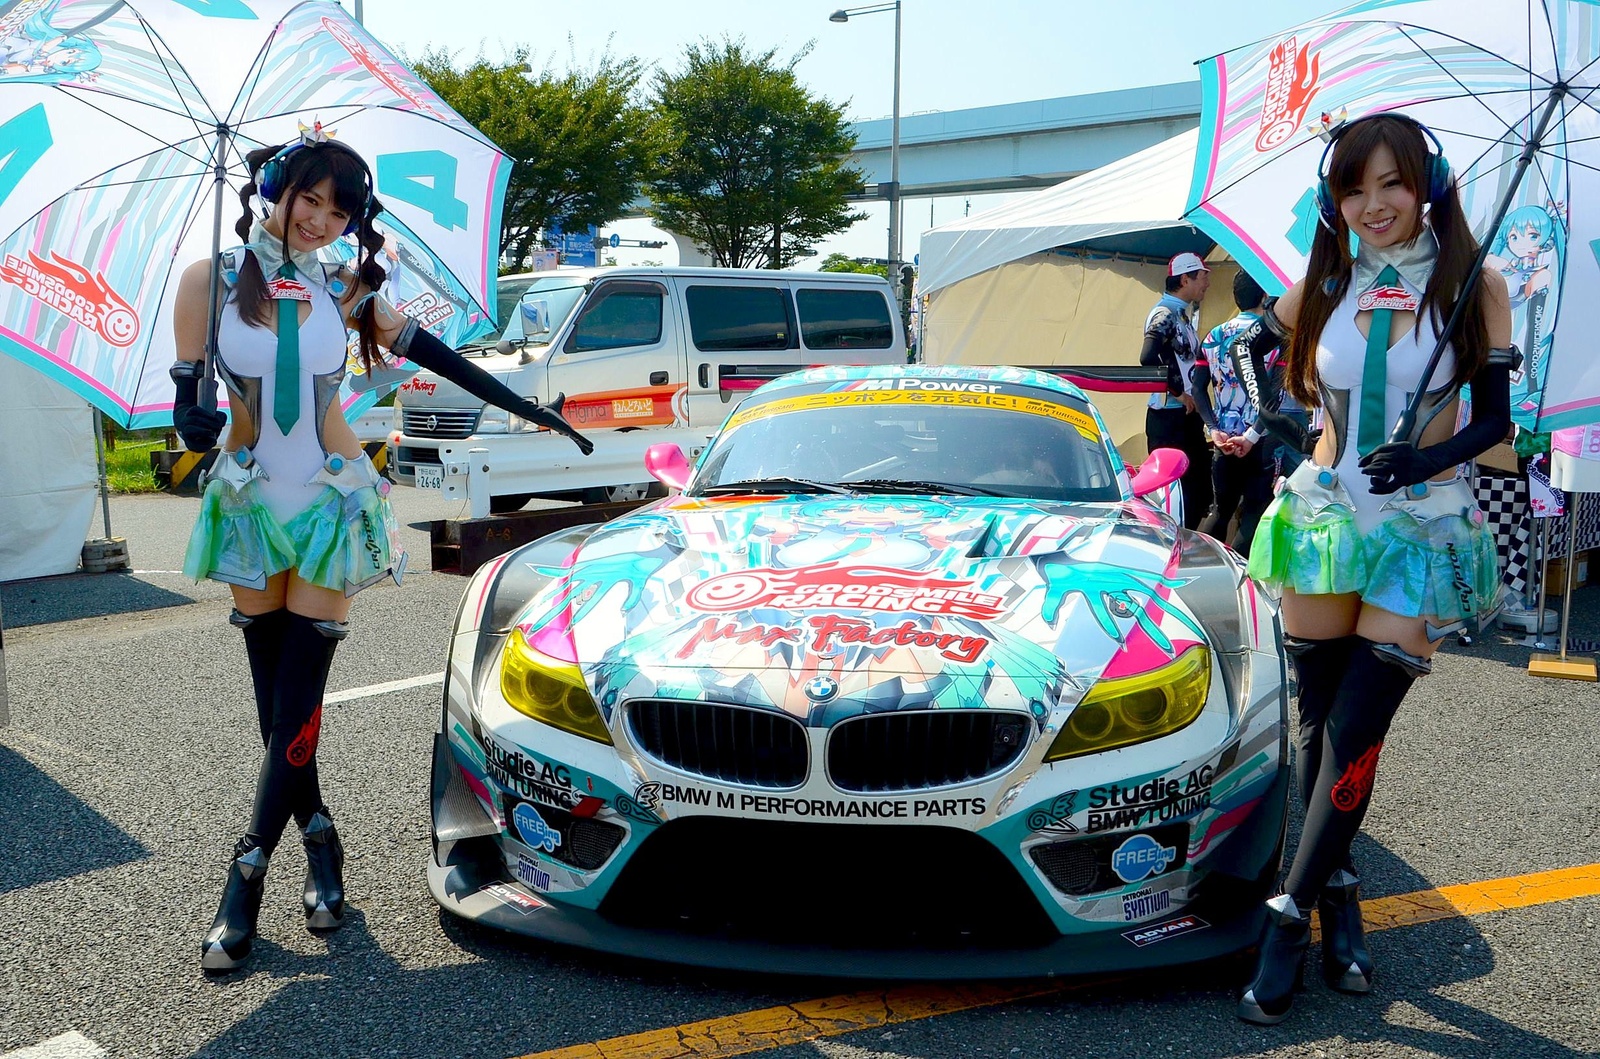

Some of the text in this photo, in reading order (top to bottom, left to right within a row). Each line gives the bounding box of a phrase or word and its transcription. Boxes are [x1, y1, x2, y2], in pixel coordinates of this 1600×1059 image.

[898, 378, 1002, 394] Power
[1051, 409, 1088, 426] TURISMO
[1446, 542, 1473, 612] CRYPTON
[768, 594, 943, 612] RACING
[793, 583, 1002, 607] GOODSMILE
[674, 614, 989, 663] Max Factory
[484, 736, 571, 788] Studie AG
[510, 775, 572, 809] TUNING
[662, 784, 986, 818] BMW M PERFORMANCE PARTS
[1088, 764, 1212, 808] Studie AG
[1087, 791, 1211, 832] BMW TUNING
[1122, 888, 1152, 902] PETRONAS
[1134, 920, 1194, 941] ADVAN
